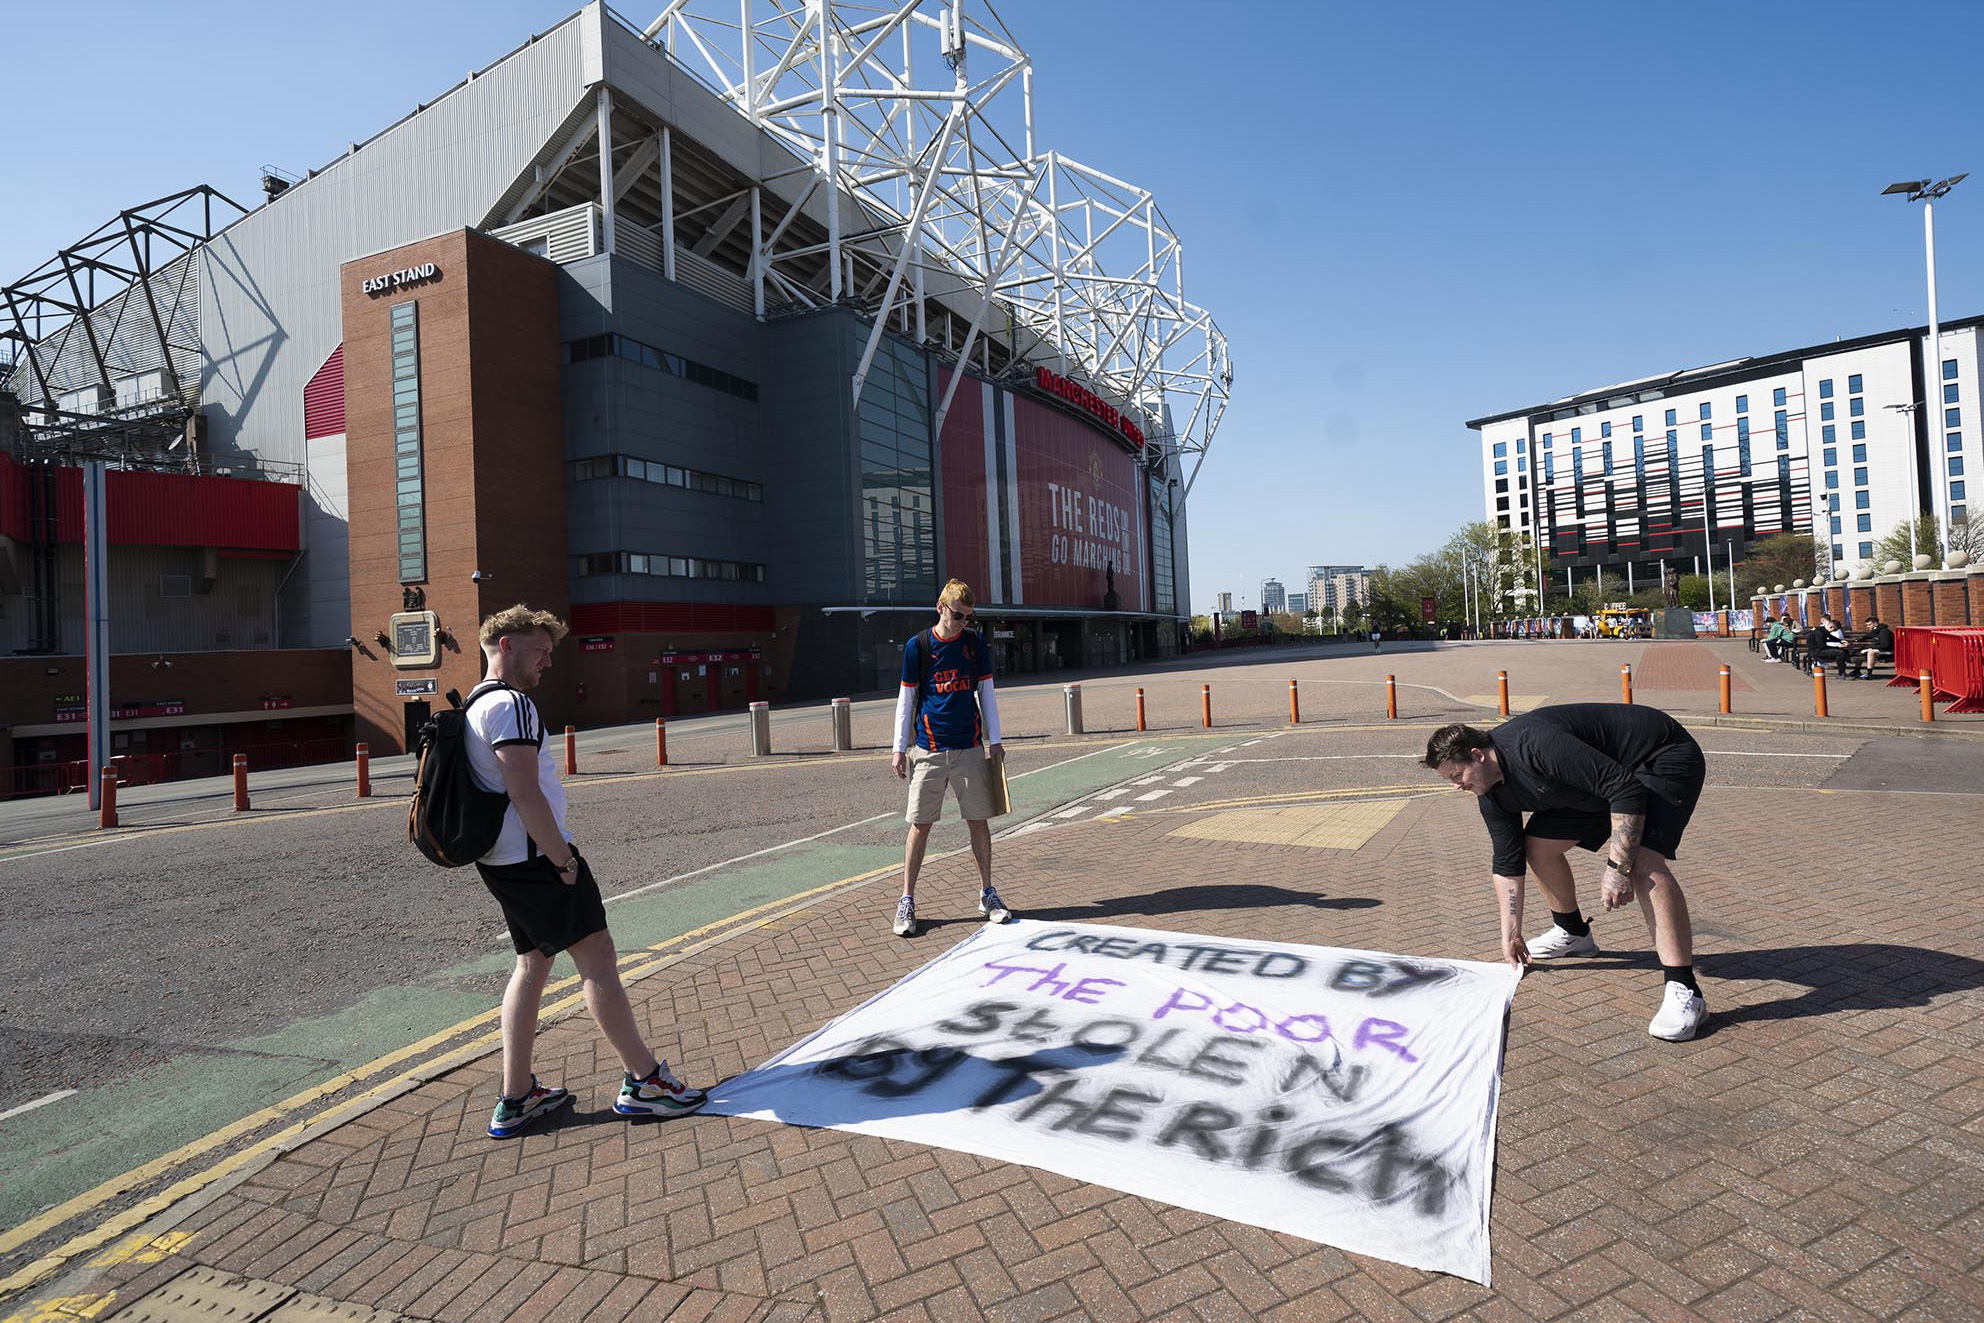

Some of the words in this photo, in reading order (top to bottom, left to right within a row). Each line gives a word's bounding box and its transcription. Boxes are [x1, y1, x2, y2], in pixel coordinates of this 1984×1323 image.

[362, 273, 390, 293] EAST
[392, 262, 435, 285] STAND
[1036, 366, 1119, 429] MANCHESTER
[1048, 482, 1083, 533] THE
[1088, 495, 1120, 543] REDS
[1051, 533, 1068, 565] GO
[1073, 538, 1122, 574] MARCHING
[934, 669, 958, 682] GET
[57, 713, 76, 721] E31
[166, 706, 183, 714] E31
[1025, 931, 1307, 978] CREATED
[1326, 960, 1458, 998] BY
[1153, 987, 1418, 1063] POOR
